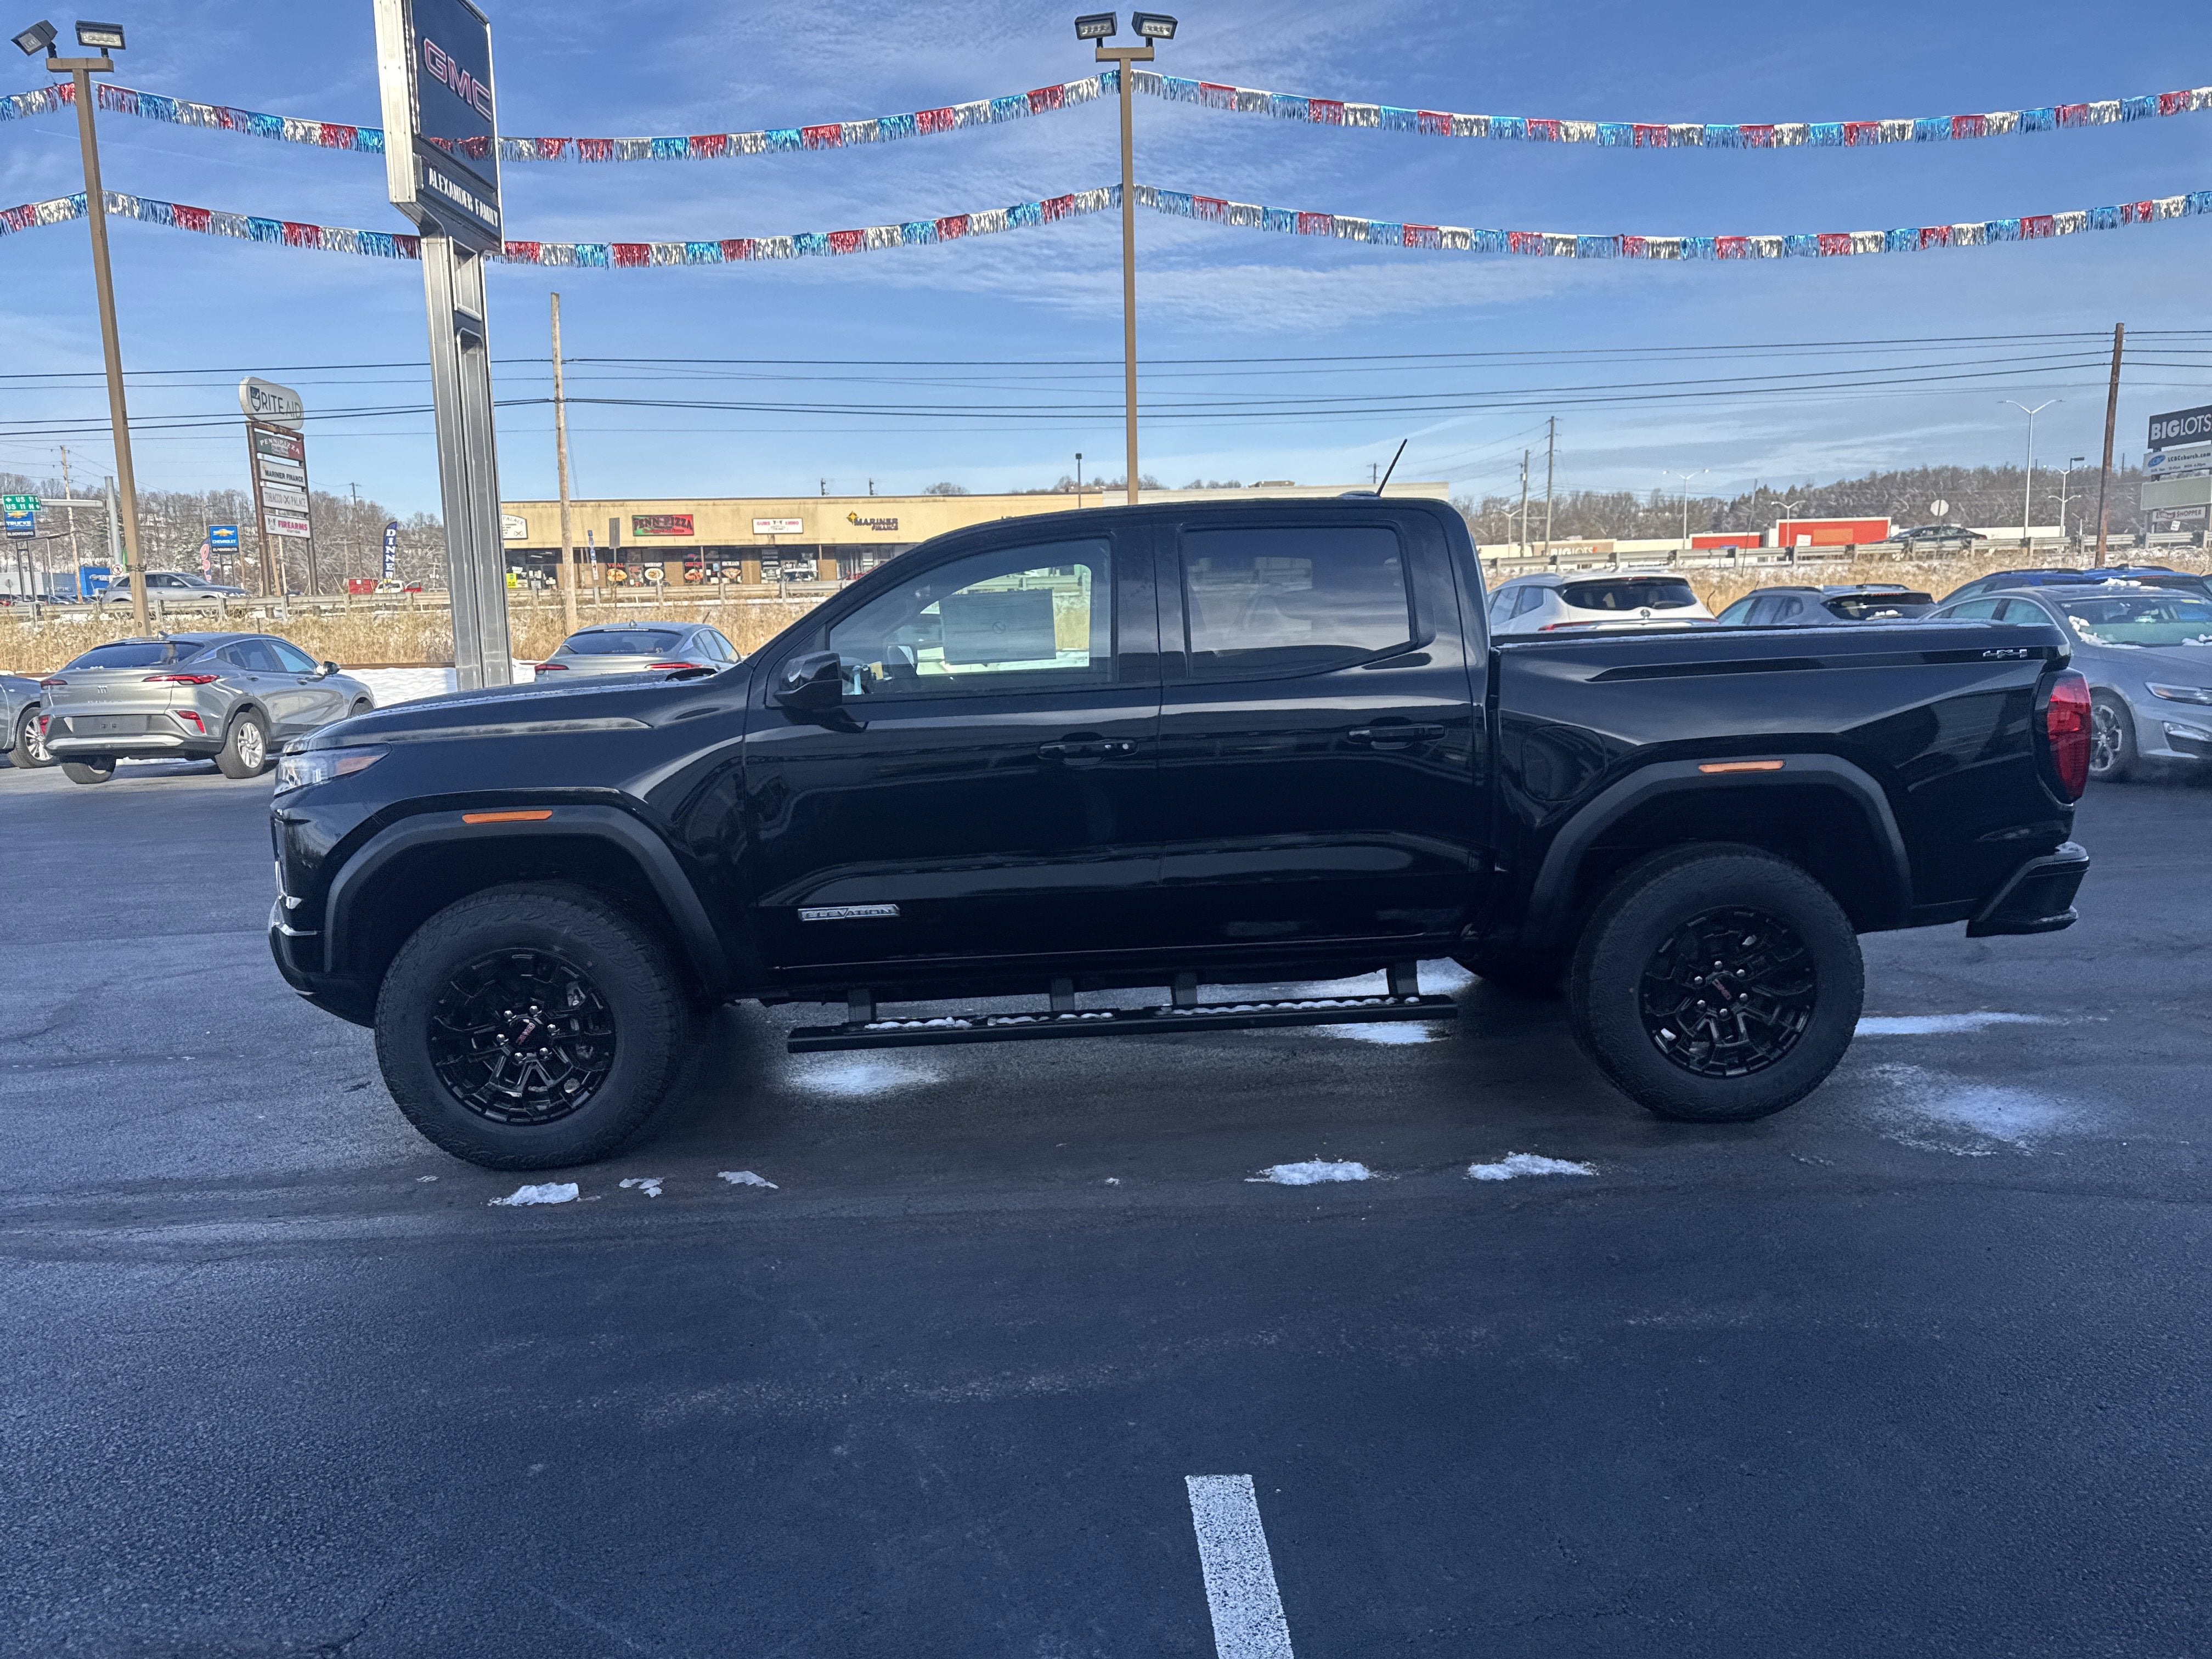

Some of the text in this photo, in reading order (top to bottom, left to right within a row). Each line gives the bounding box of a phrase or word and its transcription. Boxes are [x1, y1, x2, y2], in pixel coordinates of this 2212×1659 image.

[424, 37, 492, 122] GMC
[429, 167, 498, 228] ALEXANDER FAMILY
[261, 391, 302, 419] RITE AID
[259, 437, 279, 447] PENN
[279, 439, 300, 454] PIZZA
[265, 469, 304, 483] MARINER FINANCE
[264, 492, 307, 507] TOBACCO PALACE
[278, 520, 308, 531] FIREARMS
[503, 515, 524, 526] PALACE
[633, 517, 693, 531] PENN PIZZA
[385, 528, 396, 579] DINNER
[805, 909, 891, 918] ELEVATION
